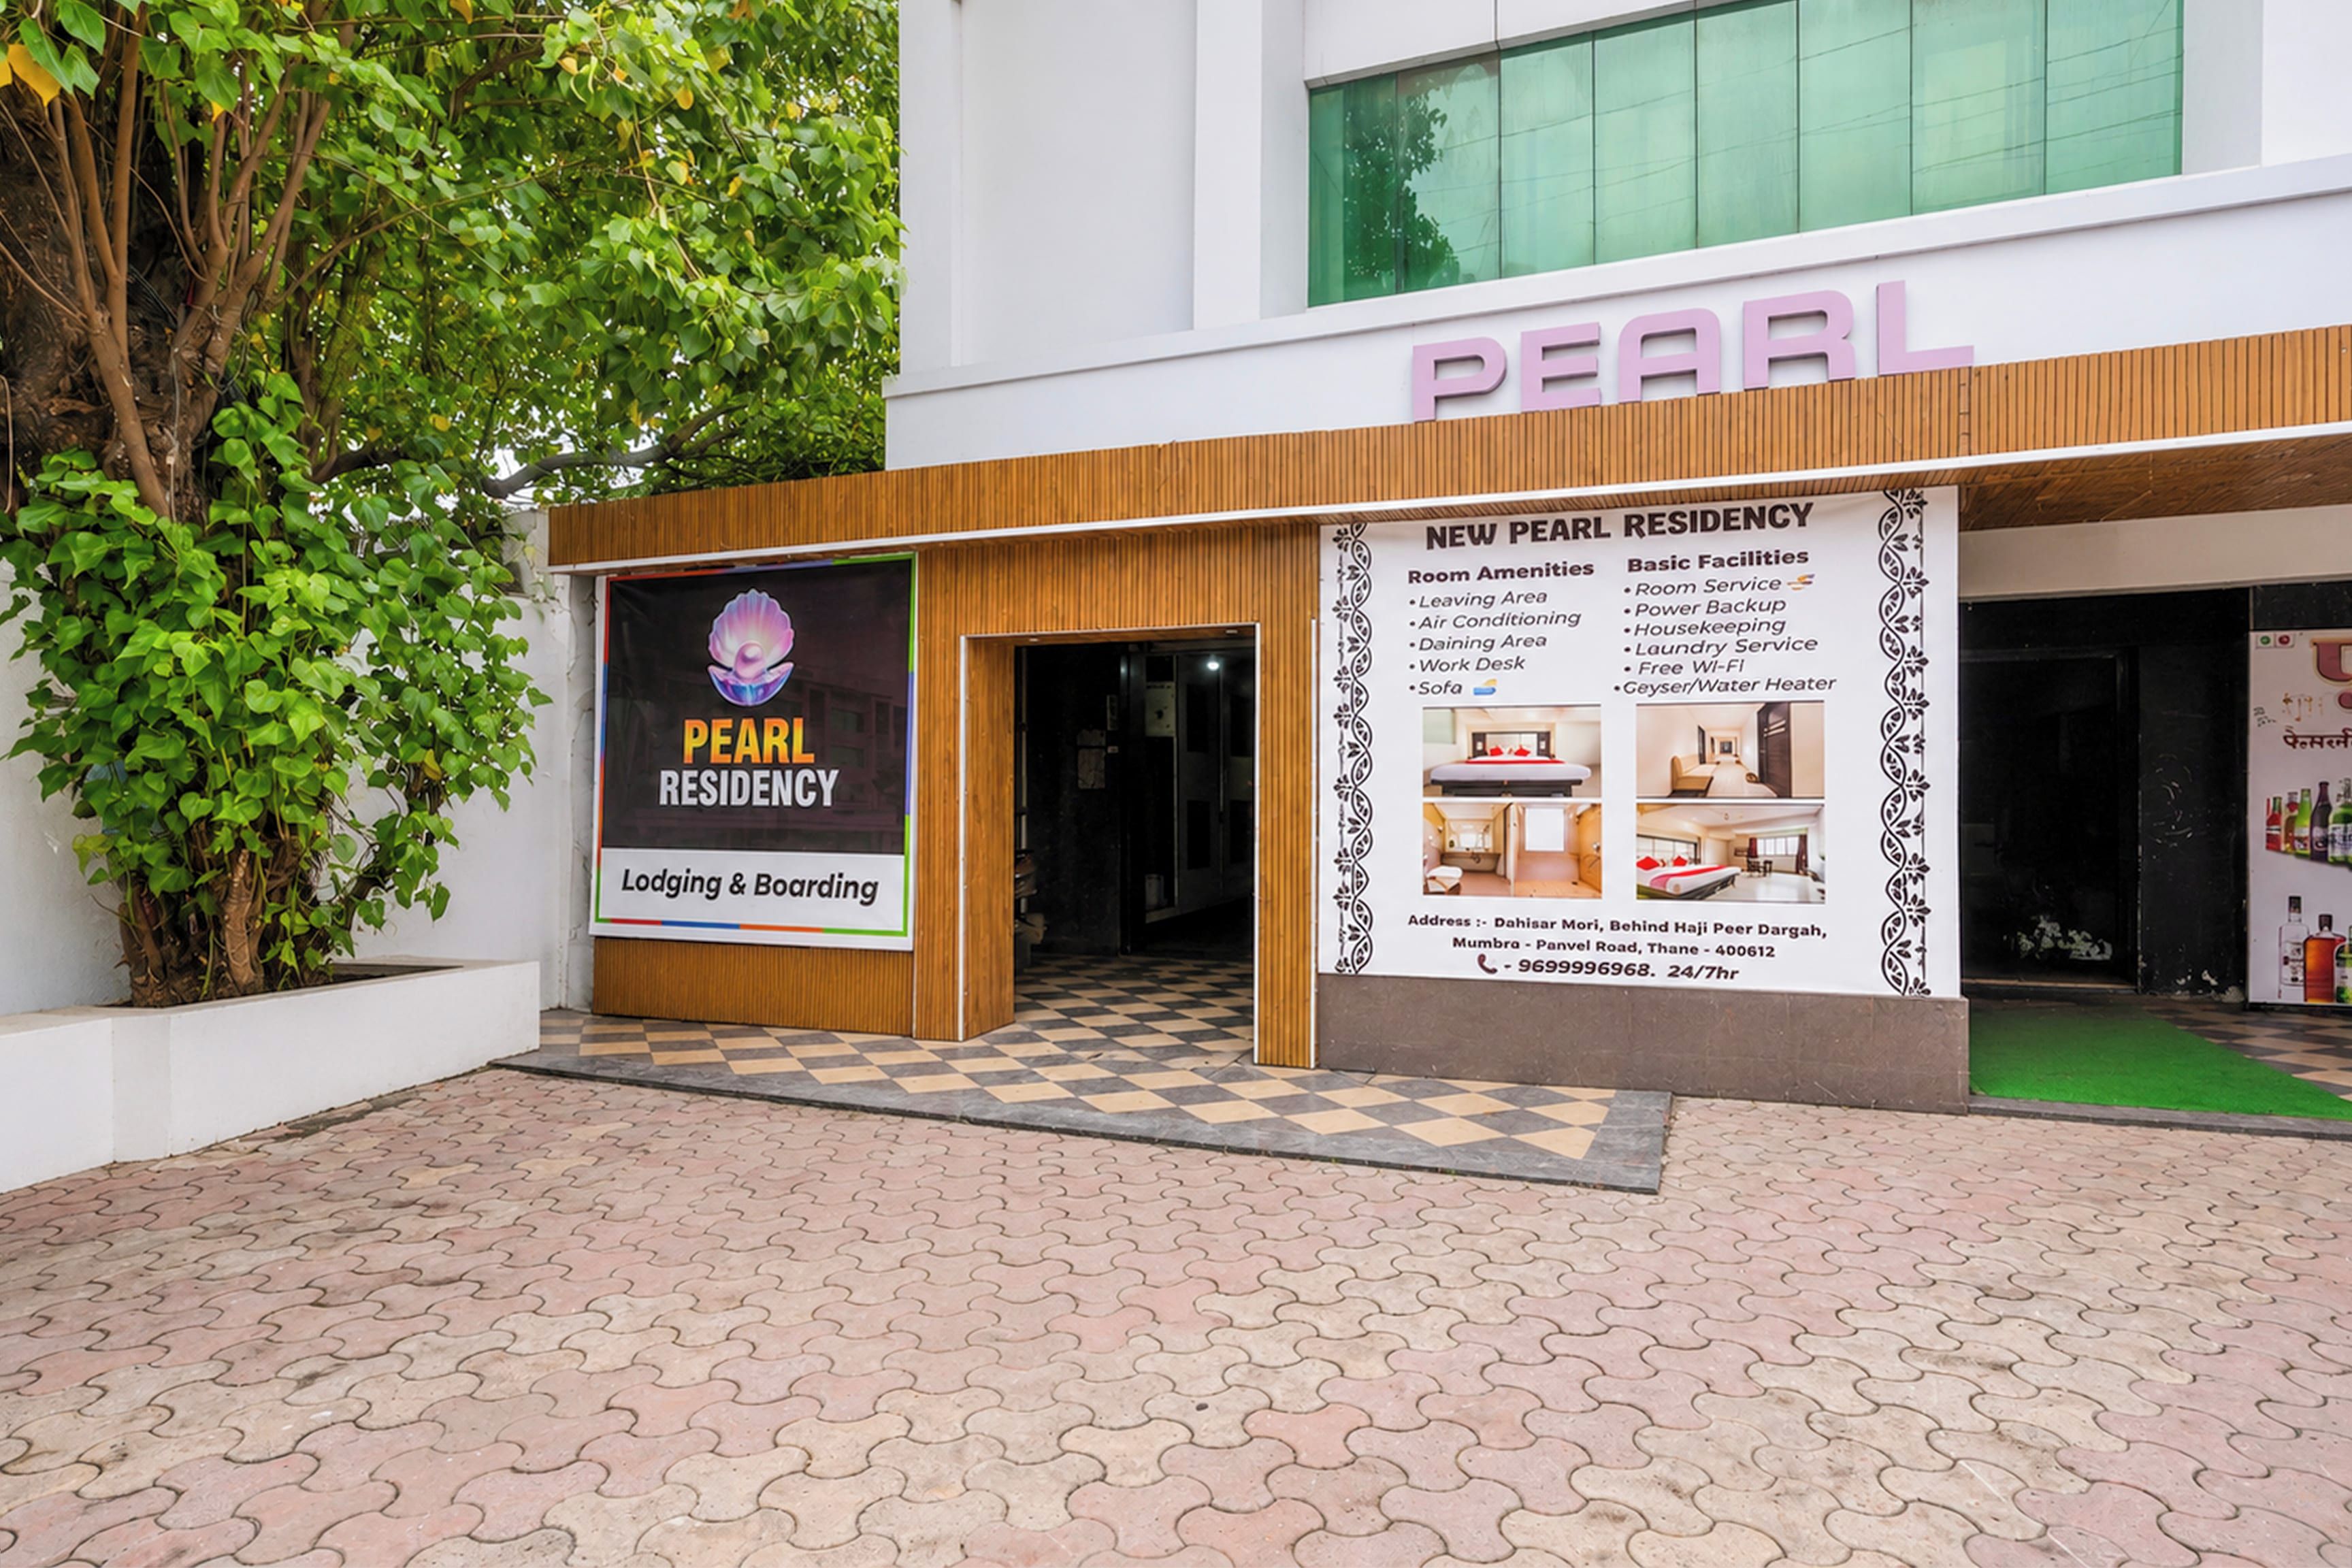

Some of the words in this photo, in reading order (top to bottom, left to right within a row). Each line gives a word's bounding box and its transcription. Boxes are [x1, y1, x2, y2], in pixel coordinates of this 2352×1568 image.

[1412, 280, 1974, 423] PEARL
[1426, 523, 1497, 550] NEW
[1509, 517, 1611, 544] PEARL
[1624, 504, 1814, 538] RESIDENCY
[1627, 555, 1690, 572] Basic
[1698, 549, 1809, 569] Facilities
[1408, 570, 1470, 584] Room
[1477, 561, 1594, 581] Amenities
[1635, 583, 1697, 596] Room
[1703, 576, 1782, 593] Service
[1419, 592, 1495, 609] Leaving
[1501, 591, 1547, 605] Area
[1635, 603, 1701, 617] Power
[1705, 598, 1786, 615] Backup
[1418, 615, 1447, 629] Air
[1452, 611, 1582, 627] Conditioning
[1634, 617, 1786, 637] Housekeeping
[1418, 636, 1495, 653] Daining
[1500, 634, 1547, 649] Area
[1635, 640, 1727, 658] Laundry
[1735, 636, 1818, 653] Service
[1418, 658, 1471, 672] Work
[1475, 655, 1526, 672] Desk
[1638, 661, 1684, 675] Free
[1418, 680, 1463, 695] Sofa
[1765, 677, 1837, 691] Heater
[683, 717, 815, 764] PEARL
[659, 768, 839, 806] RESIDENCY
[622, 868, 722, 900] Lodging
[729, 872, 747, 895] &
[753, 873, 879, 906] Boarding
[1408, 915, 1471, 926] Address
[1494, 917, 1556, 930] Dahisar
[1562, 919, 1603, 932] Mori,
[1610, 920, 1668, 932] Behind
[1674, 921, 1708, 936] Haji
[1714, 923, 1752, 935] Peer
[1758, 924, 1827, 939] Dargah,
[1453, 937, 1520, 949] Mumbra
[1536, 939, 1590, 951] Panvel
[1596, 941, 1642, 954] Road,
[1647, 943, 1699, 955] Thane
[1715, 945, 1776, 958] 400612
[1667, 964, 1740, 980] 24/7hr
